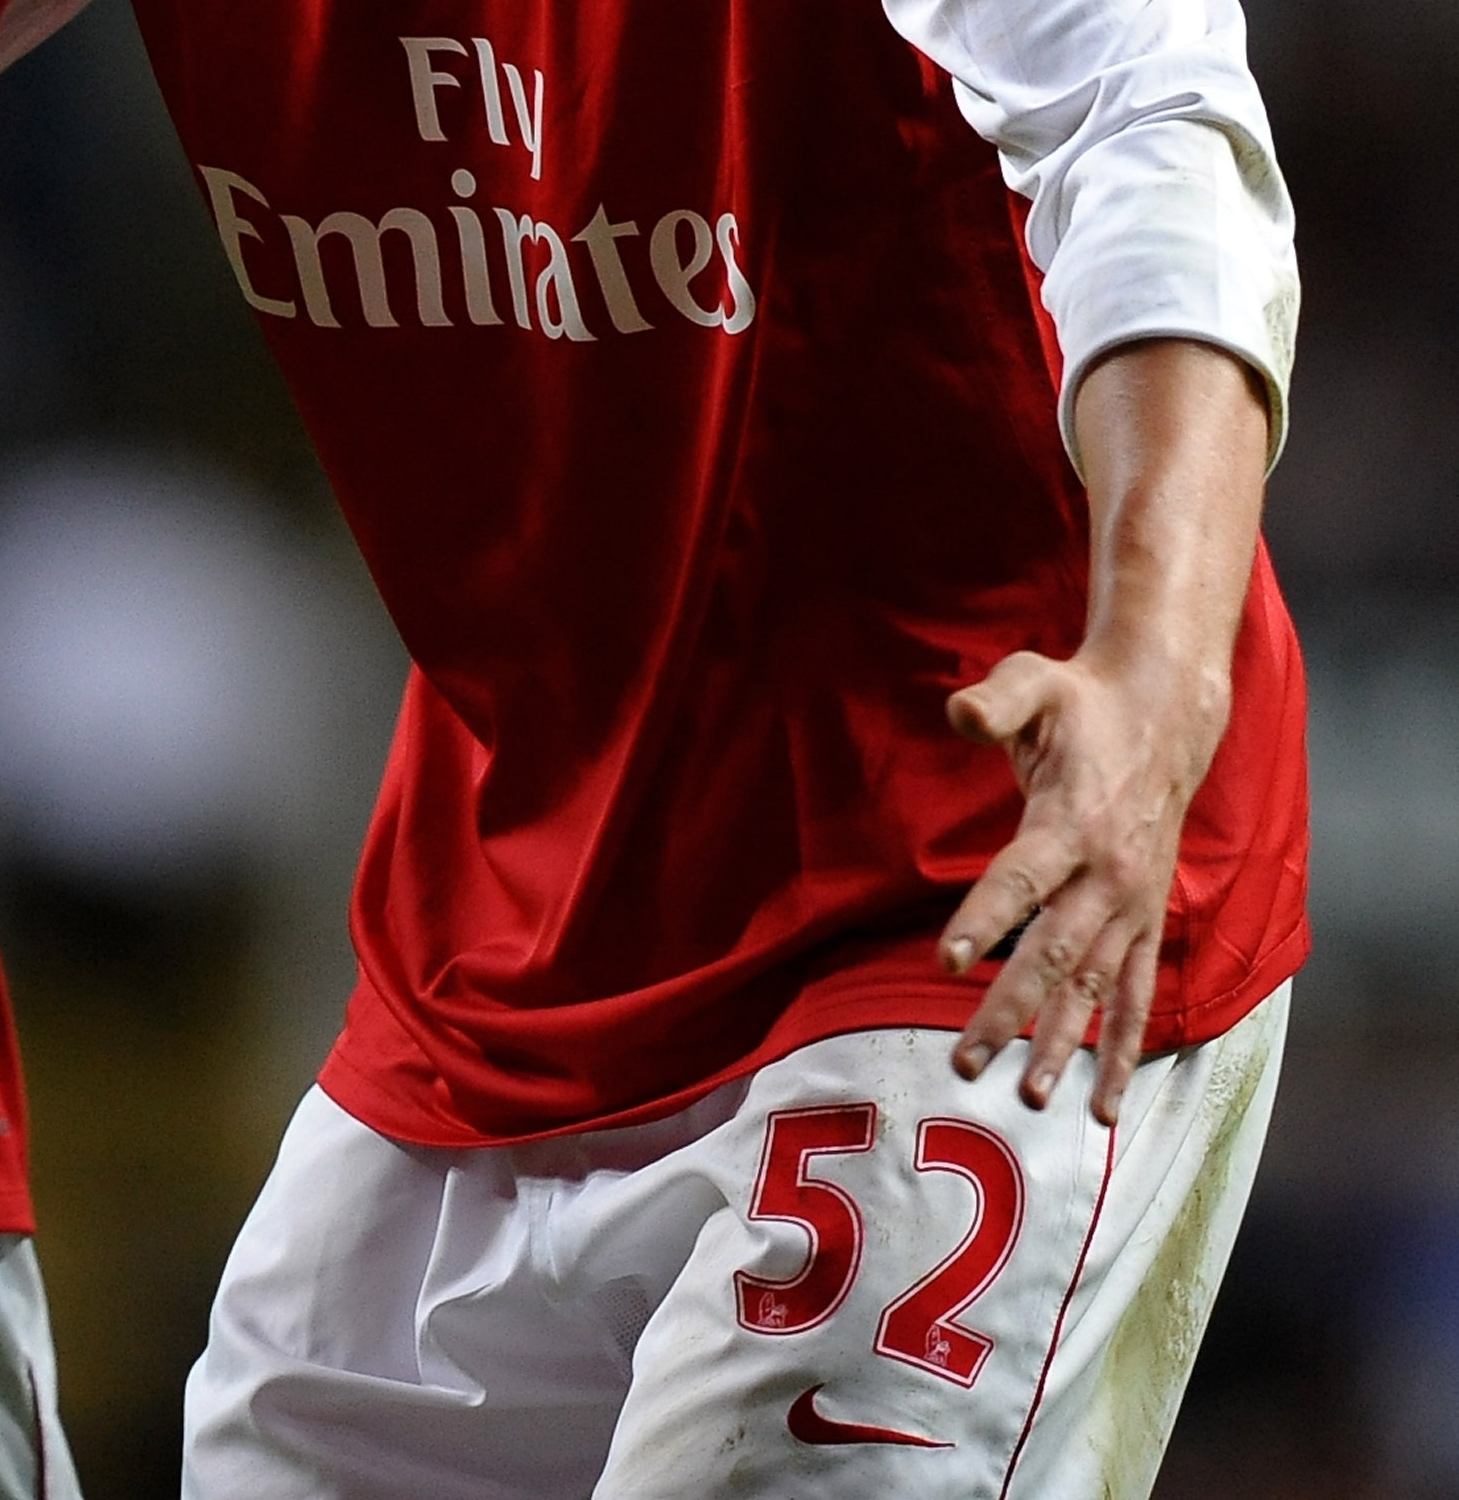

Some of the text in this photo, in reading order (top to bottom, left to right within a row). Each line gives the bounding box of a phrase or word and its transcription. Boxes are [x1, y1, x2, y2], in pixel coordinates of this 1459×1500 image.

[398, 36, 544, 181] Fly
[197, 163, 757, 342] Emirates
[733, 1102, 1028, 1389] 52
